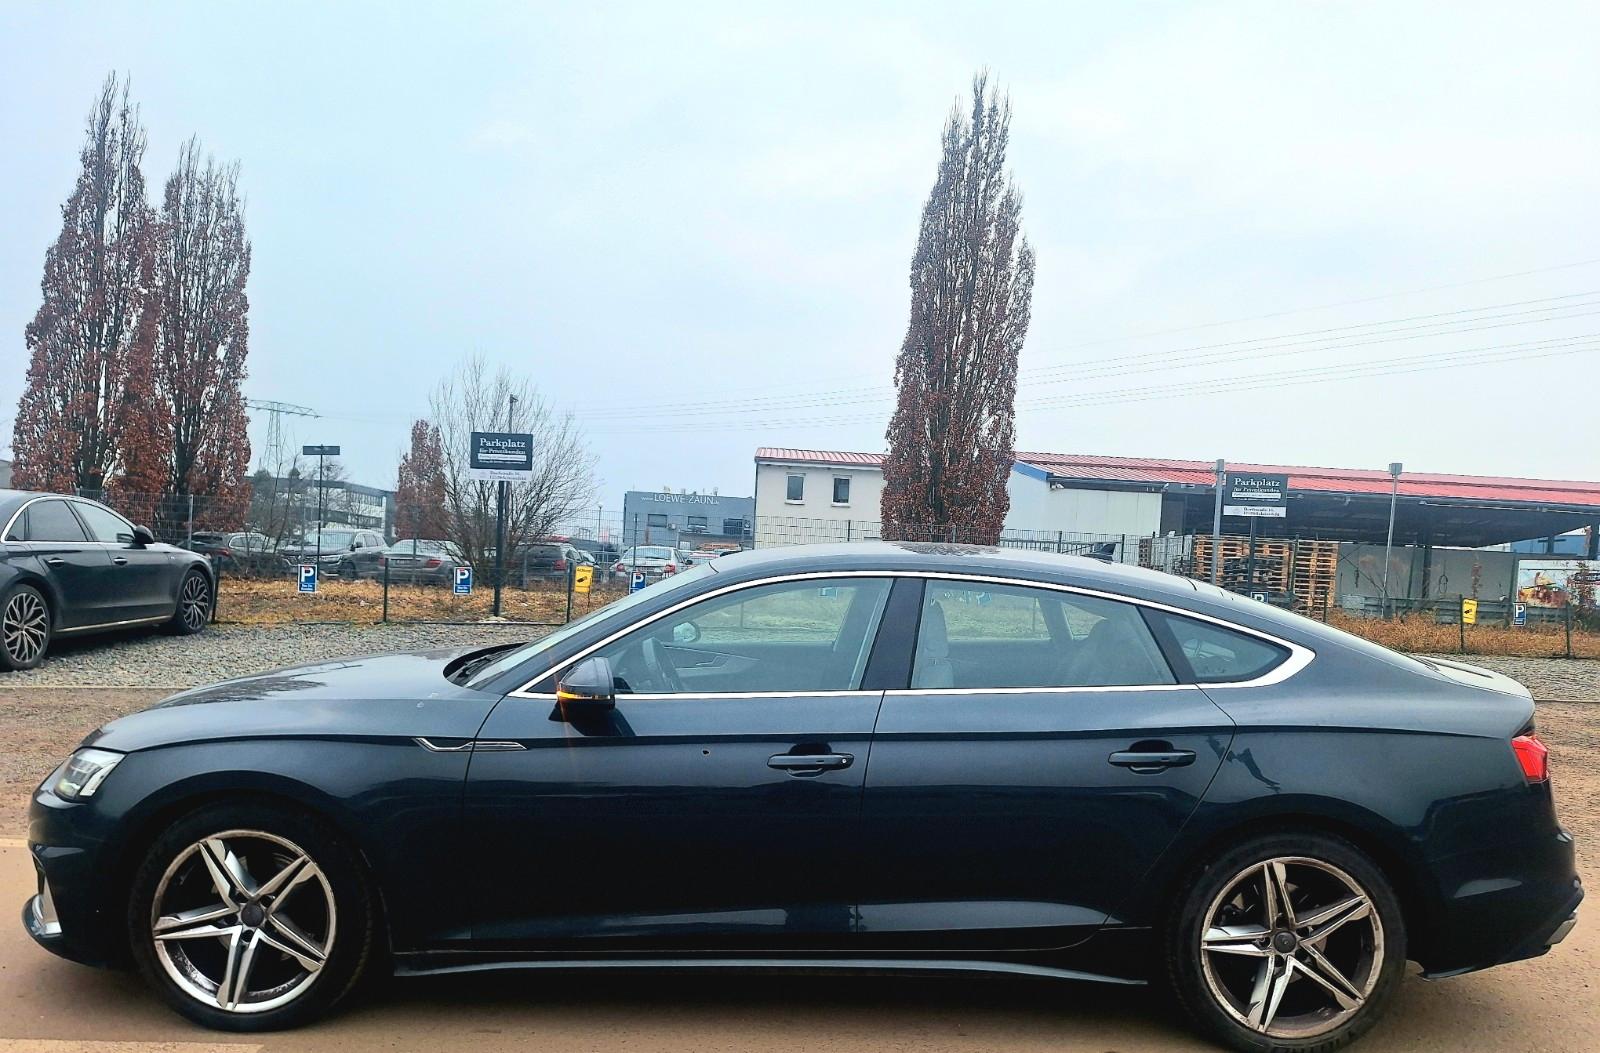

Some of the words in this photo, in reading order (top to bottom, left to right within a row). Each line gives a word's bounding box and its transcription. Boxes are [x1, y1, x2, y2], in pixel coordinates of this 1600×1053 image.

[479, 437, 526, 449] Parkplatz
[1234, 477, 1281, 488] Parkplatz
[301, 567, 314, 582] P
[457, 569, 469, 584] P
[632, 573, 644, 588] P
[1515, 604, 1524, 617] P
